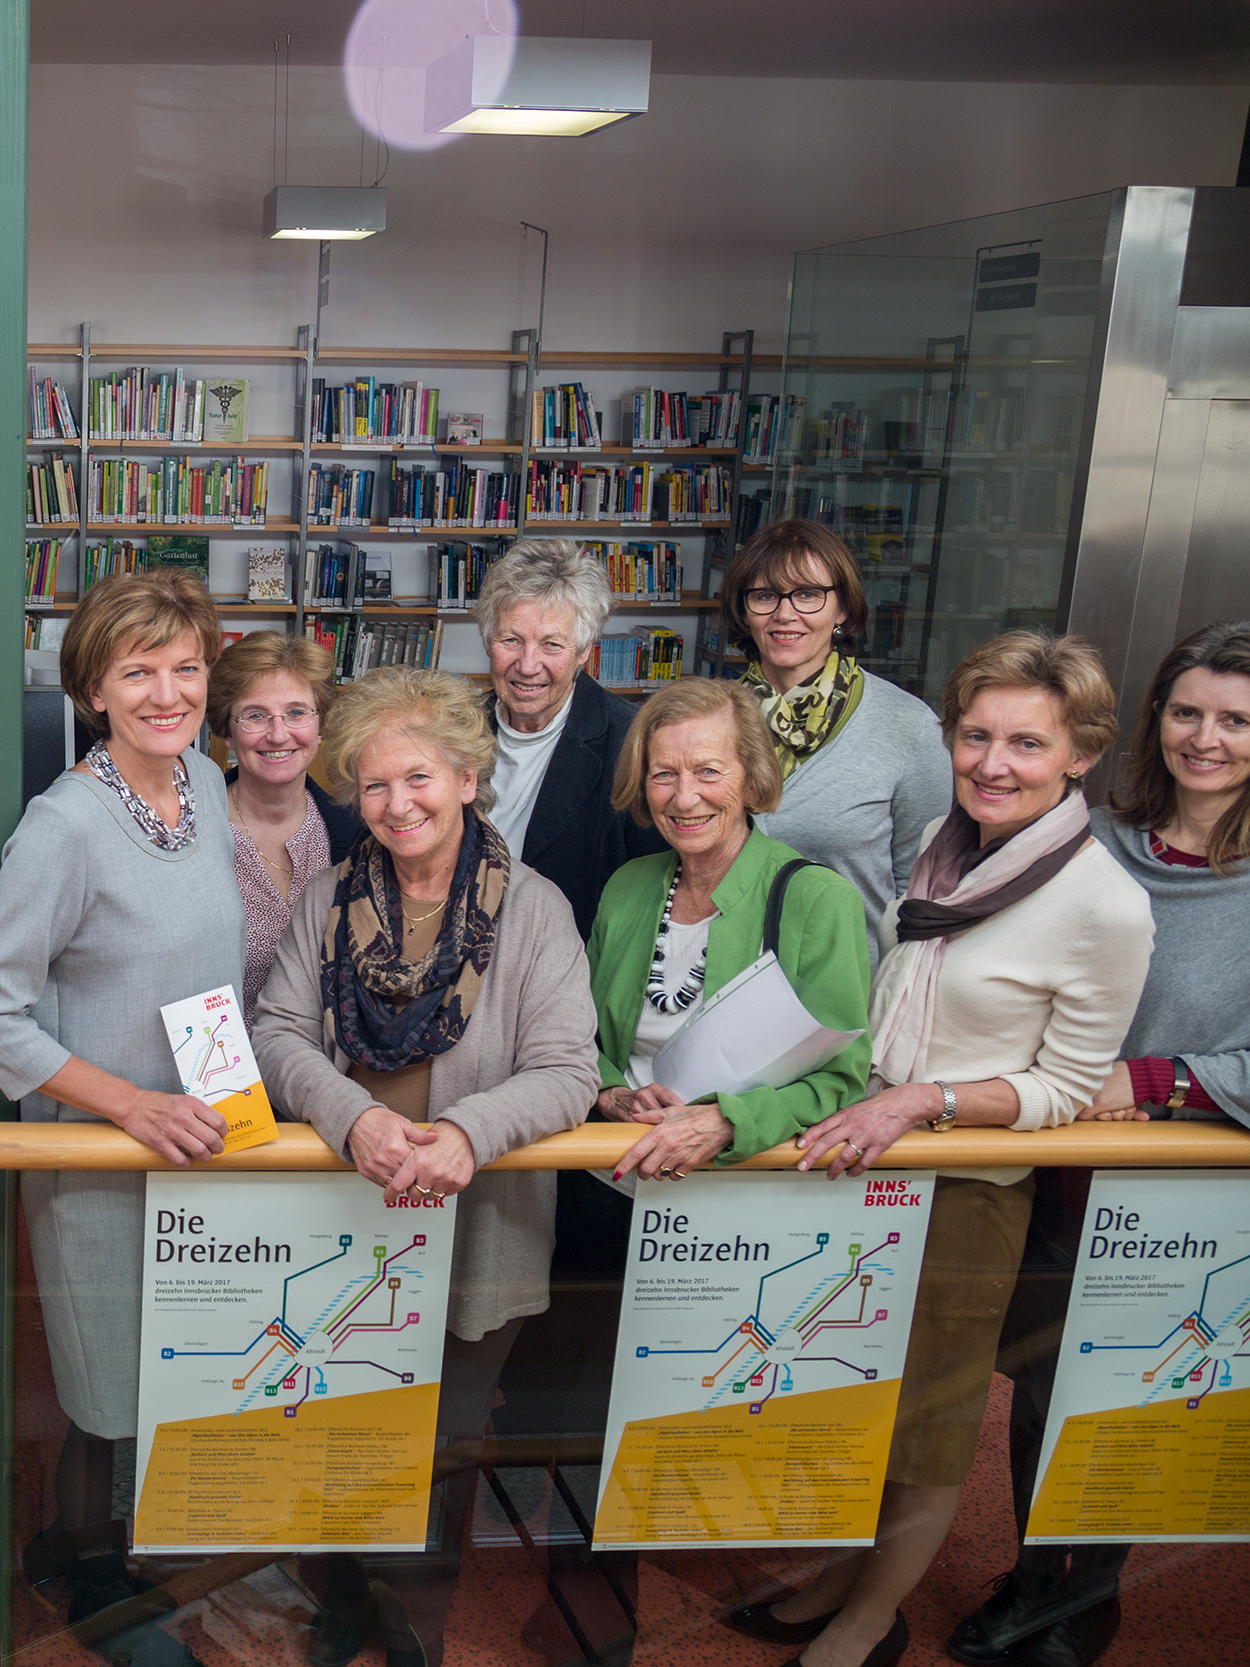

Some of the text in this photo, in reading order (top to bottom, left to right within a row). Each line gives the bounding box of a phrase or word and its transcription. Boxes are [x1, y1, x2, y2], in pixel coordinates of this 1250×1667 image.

[160, 551, 198, 560] Gartenlust
[204, 992, 224, 1006] INNS'
[206, 998, 232, 1011] BRUCK
[866, 1180, 912, 1193] INNS'
[384, 1196, 445, 1208] BRUCK
[864, 1194, 921, 1207] BRUCK
[157, 1208, 205, 1235] Die
[642, 1208, 689, 1234] Die
[1094, 1205, 1140, 1231] Die
[155, 1236, 292, 1263] Dreizehn
[638, 1235, 771, 1262] Dreizehn
[1089, 1232, 1218, 1259] Dreizehn
